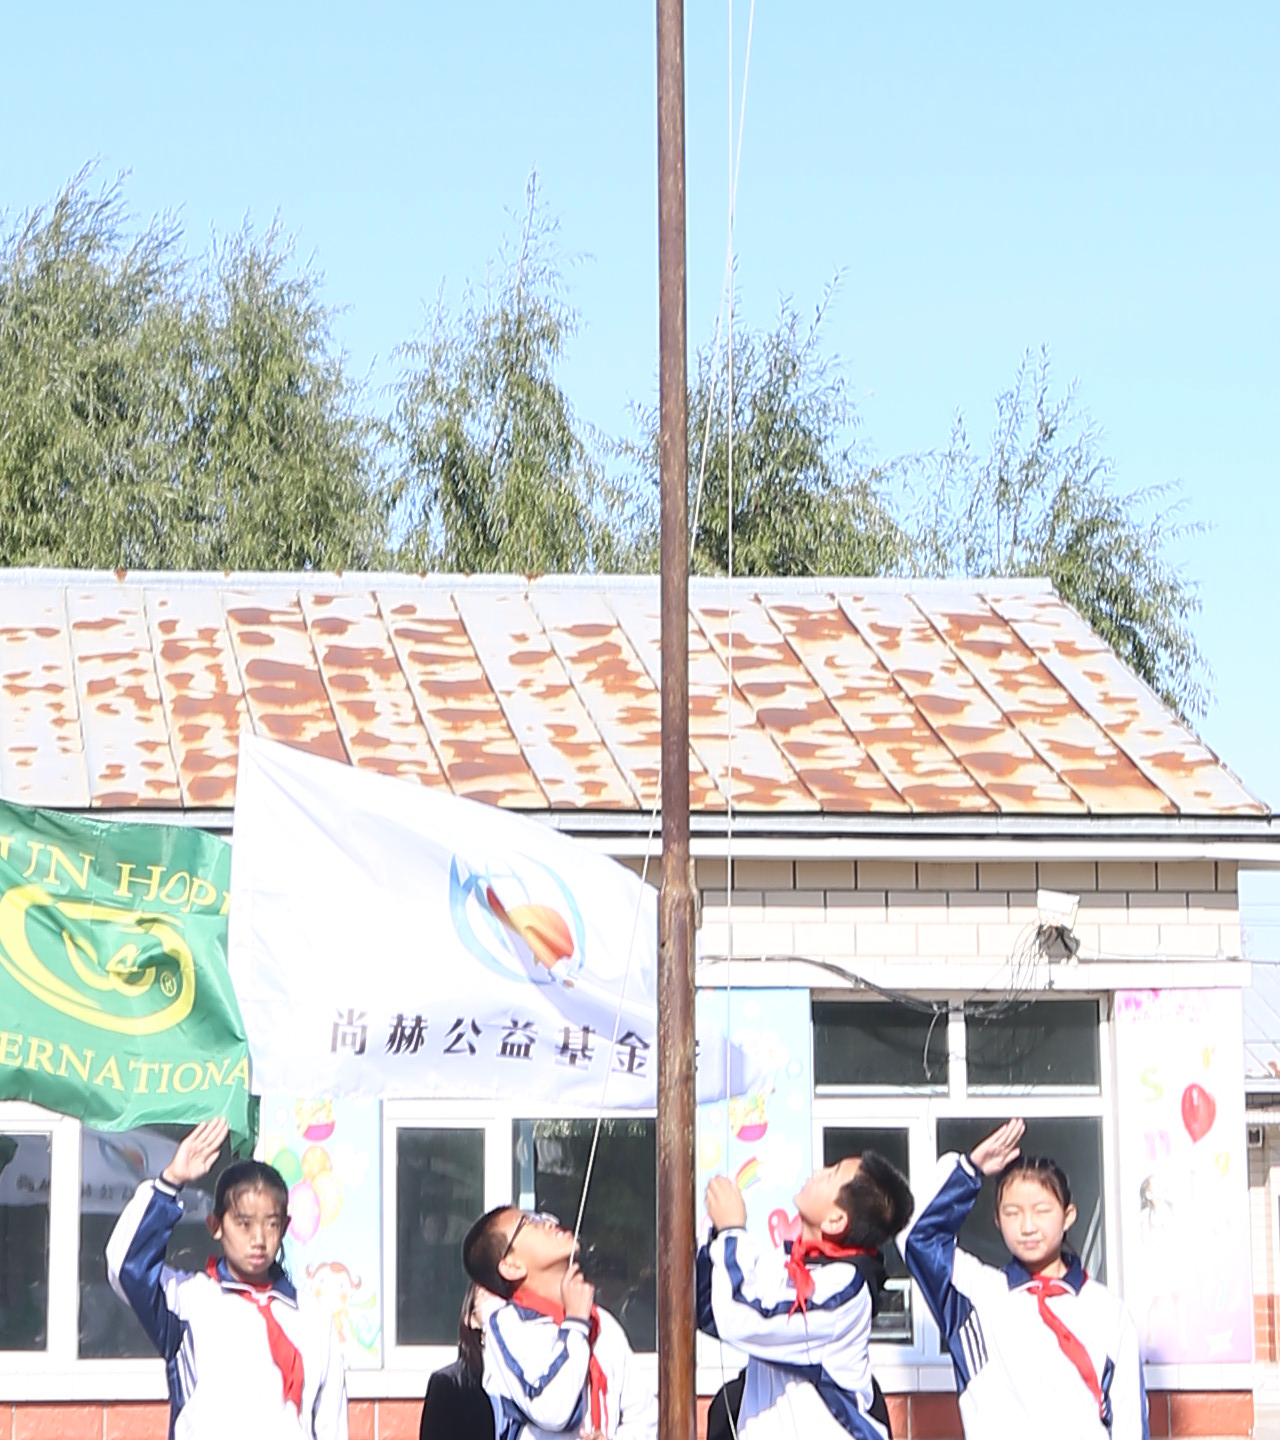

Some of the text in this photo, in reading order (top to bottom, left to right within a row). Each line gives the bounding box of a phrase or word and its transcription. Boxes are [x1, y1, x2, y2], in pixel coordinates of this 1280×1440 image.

[114, 862, 230, 916] HOP
[330, 1008, 702, 1080] 尚赫公益基金
